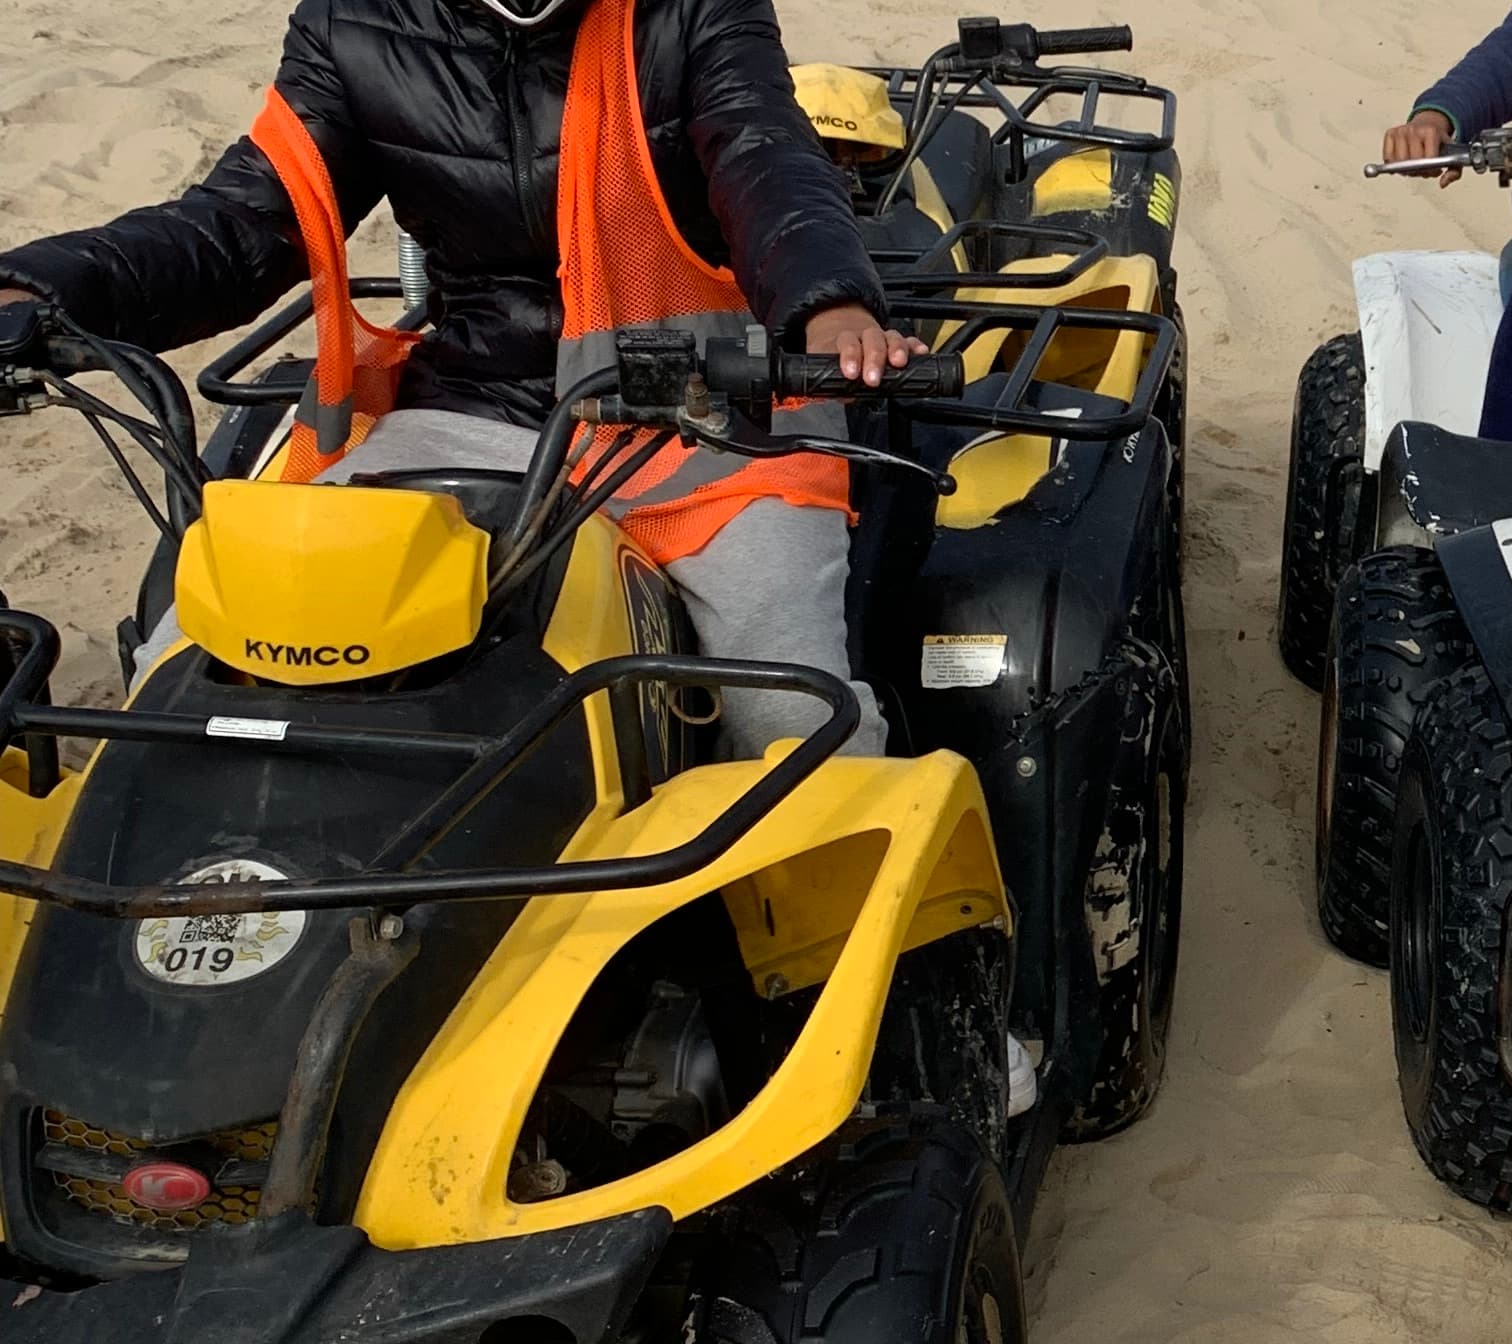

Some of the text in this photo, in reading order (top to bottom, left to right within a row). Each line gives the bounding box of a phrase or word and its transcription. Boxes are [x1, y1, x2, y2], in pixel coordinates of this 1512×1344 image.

[808, 115, 858, 131] MCO
[947, 636, 994, 644] WARNING
[244, 638, 370, 667] KYMCO
[164, 946, 234, 973] 019
